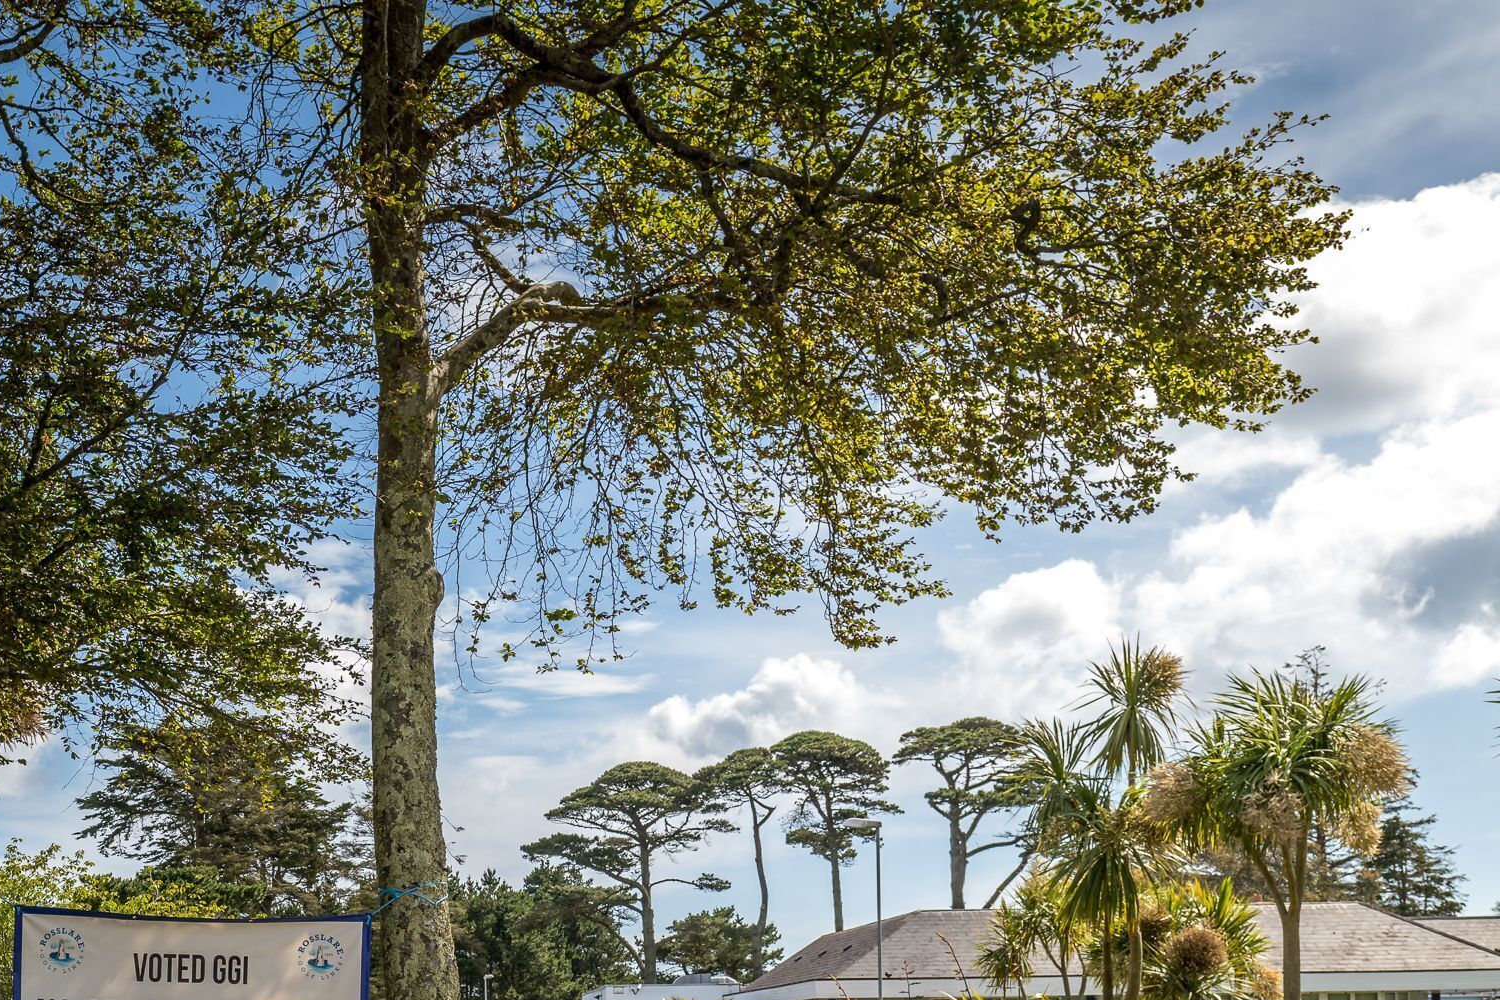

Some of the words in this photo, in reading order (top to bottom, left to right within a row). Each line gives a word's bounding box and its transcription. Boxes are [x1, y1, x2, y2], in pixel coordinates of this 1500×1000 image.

[40, 927, 85, 948] ROSSLARE
[298, 934, 344, 955] ROSSLARE
[133, 952, 206, 984] VOTED
[212, 955, 249, 985] GGI
